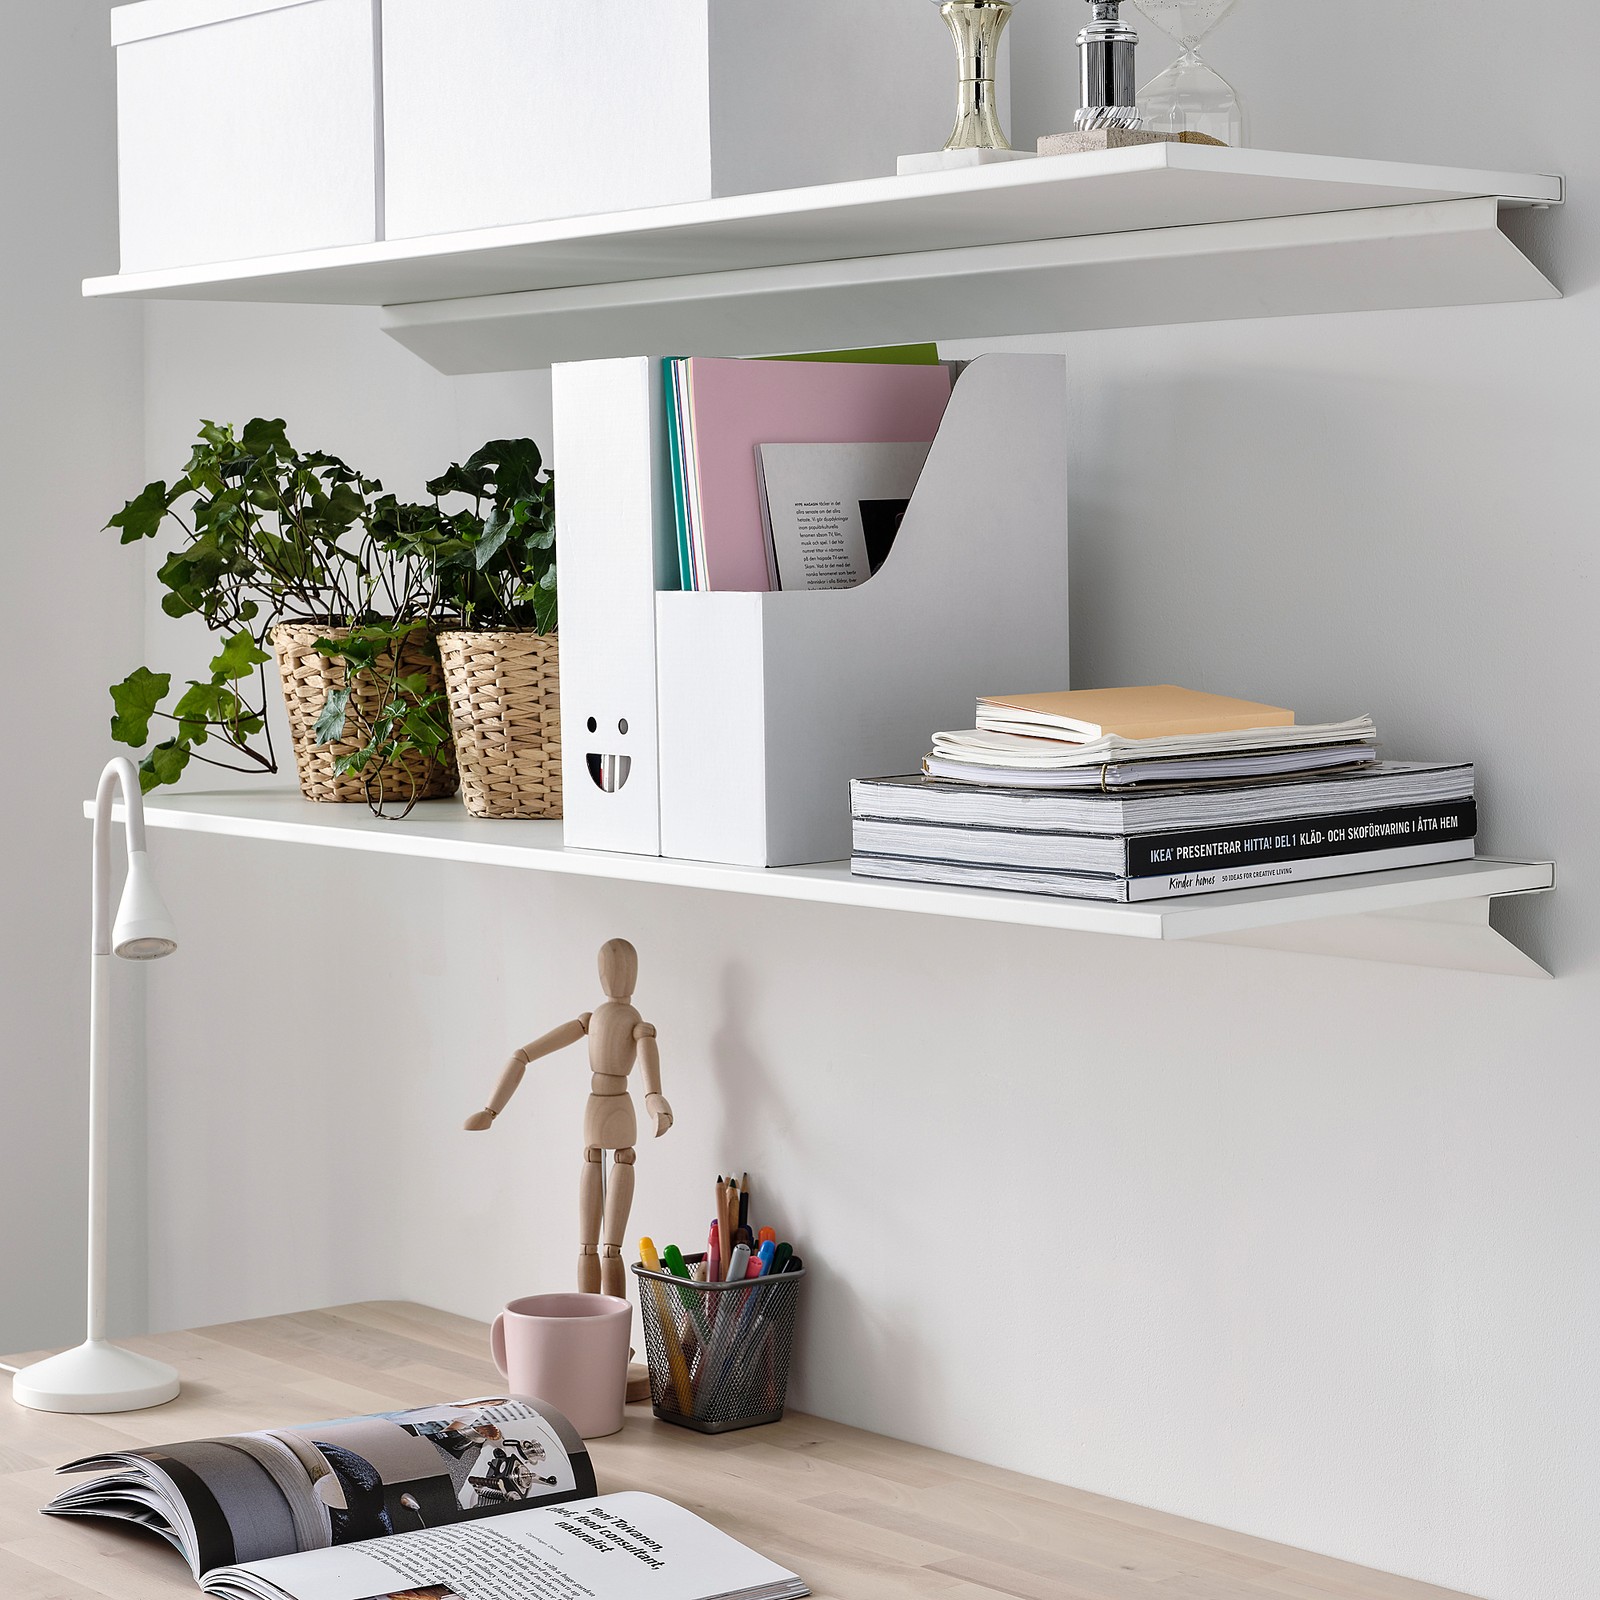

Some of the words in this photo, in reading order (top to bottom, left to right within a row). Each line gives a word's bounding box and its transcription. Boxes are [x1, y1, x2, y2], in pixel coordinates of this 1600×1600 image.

[1176, 840, 1241, 860] PRESENTERAR
[1244, 836, 1272, 852] HITTA!
[1275, 835, 1290, 849] DEL
[1292, 834, 1296, 847] 1
[1300, 829, 1325, 846] KLÄD-
[1328, 828, 1345, 842] OCH
[1348, 820, 1410, 840] SKOFÖRVARING
[1412, 820, 1415, 832] I
[1418, 816, 1438, 832] ÅTTA
[1440, 815, 1458, 829] HEM
[1169, 874, 1193, 890] Kinder
[1195, 874, 1215, 886] homes
[1253, 870, 1275, 878] CREATIVE
[1277, 868, 1292, 876] LIVING
[555, 1520, 615, 1554] naturalist
[574, 1515, 605, 1531] food
[600, 1530, 665, 1570] consultant,
[587, 1507, 616, 1522] Toni
[612, 1518, 664, 1552] Toivanen,
